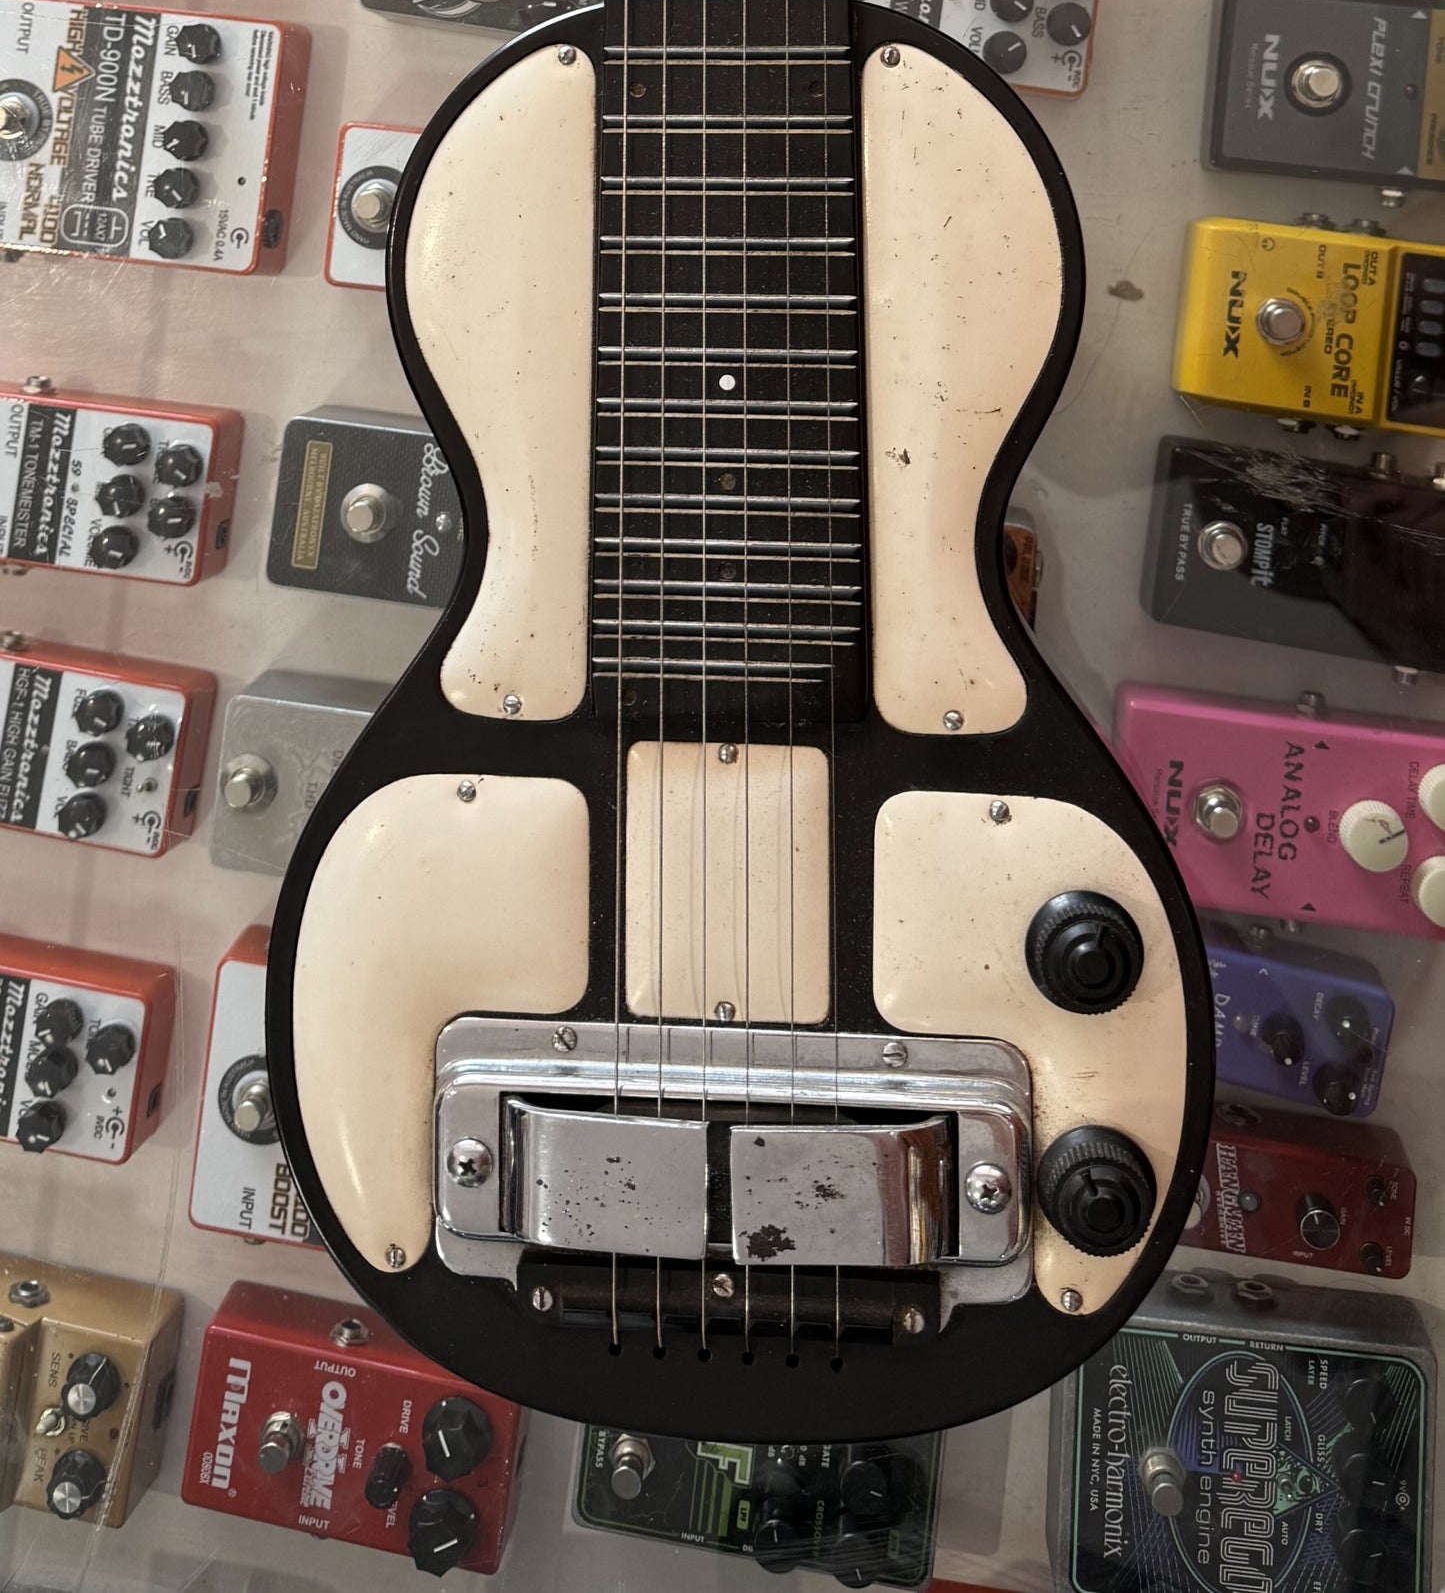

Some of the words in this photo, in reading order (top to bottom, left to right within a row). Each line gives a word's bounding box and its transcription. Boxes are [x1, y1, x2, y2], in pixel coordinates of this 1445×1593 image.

[15, 1, 36, 55] OUTPUT
[1031, 7, 1048, 38] BASS
[94, 13, 127, 103] TD-900N
[163, 25, 179, 57] GAIN
[158, 70, 174, 105] BASS
[1256, 33, 1281, 121] NUX
[89, 105, 109, 144] TUBE
[111, 14, 157, 204] Mozztronics
[80, 147, 105, 204] DRIVER
[18, 162, 47, 242] NORMAL
[215, 208, 230, 239] 15VAC
[213, 240, 226, 261] 0.4A
[1222, 270, 1247, 359] NUX
[1331, 333, 1354, 398] CORE
[5, 405, 25, 458] OUTPUT
[28, 418, 43, 450] TM-1
[34, 413, 72, 557] Mozztronics
[415, 442, 450, 519] Brown
[14, 453, 40, 549] TONEMEISTER
[59, 497, 78, 558] SPECIAL
[1279, 517, 1289, 536] FLAT
[1318, 523, 1328, 546] PITCH
[406, 529, 440, 600] Sound
[1250, 522, 1274, 587] STOMPit
[10, 674, 53, 823] Mozztronics
[1407, 761, 1420, 794] DELAY
[1165, 759, 1184, 848] NUX
[1277, 741, 1305, 862] ANALOG
[1405, 796, 1417, 819] TIME
[1326, 810, 1339, 844] BLEND
[1250, 812, 1276, 900] DELAY
[1399, 864, 1412, 904] REPEAT
[1312, 992, 1325, 1021] DECAY
[1299, 1061, 1310, 1086] LEVEL
[93, 1115, 104, 1139] 9VDC
[238, 1186, 257, 1230] INPUT
[268, 1163, 292, 1236] BOOST
[1390, 1181, 1399, 1200] TONE
[1385, 1245, 1393, 1267] LEVEL
[1181, 1332, 1219, 1344] OUTPUT
[1249, 1341, 1286, 1352] RETURN
[48, 1351, 61, 1388] SENS
[313, 1360, 357, 1377] OUTPUT
[1306, 1360, 1316, 1386] LAYER
[1318, 1359, 1329, 1390] SPEED
[399, 1399, 413, 1434] DRIVE
[1091, 1407, 1103, 1439] MADE
[1197, 1389, 1217, 1465] synth
[1283, 1416, 1293, 1442] LATCH
[310, 1381, 347, 1511] OVERDRIVE
[352, 1438, 366, 1469] TONE
[594, 1430, 608, 1469] BYPASS
[1091, 1442, 1101, 1454] IN
[1101, 1363, 1134, 1559] electro-harmonix
[1316, 1434, 1326, 1463] GLISS
[34, 1447, 48, 1483] PEAK
[1089, 1458, 1101, 1486] NYC,
[1217, 1360, 1280, 1593] SUPEREGO
[738, 1506, 748, 1523] LPF
[1088, 1489, 1100, 1511] USA
[298, 1514, 330, 1530] INPUT
[681, 1532, 705, 1543] INPUT
[1194, 1475, 1215, 1565] engine
[1280, 1521, 1289, 1546] AUTO
[1314, 1513, 1324, 1534] DRY
